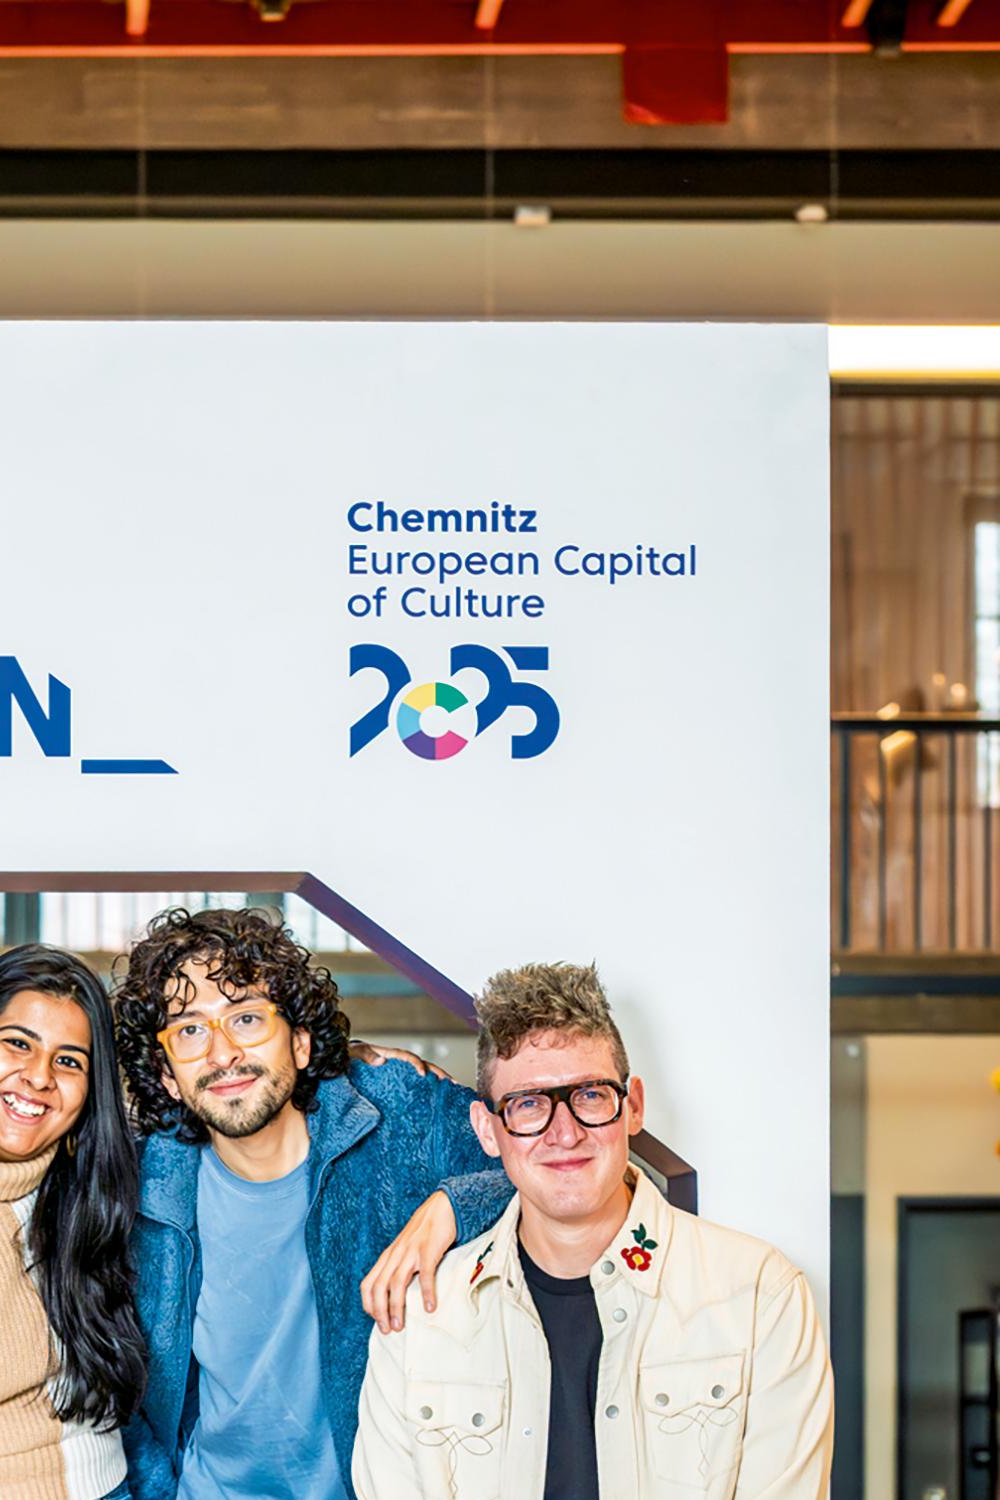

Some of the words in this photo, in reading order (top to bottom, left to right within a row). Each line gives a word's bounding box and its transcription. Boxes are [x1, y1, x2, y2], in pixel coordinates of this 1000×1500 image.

[347, 501, 537, 532] Chemnitz
[348, 545, 539, 583] European
[554, 545, 696, 584] Capital
[347, 587, 387, 617] of
[400, 587, 545, 617] Culture
